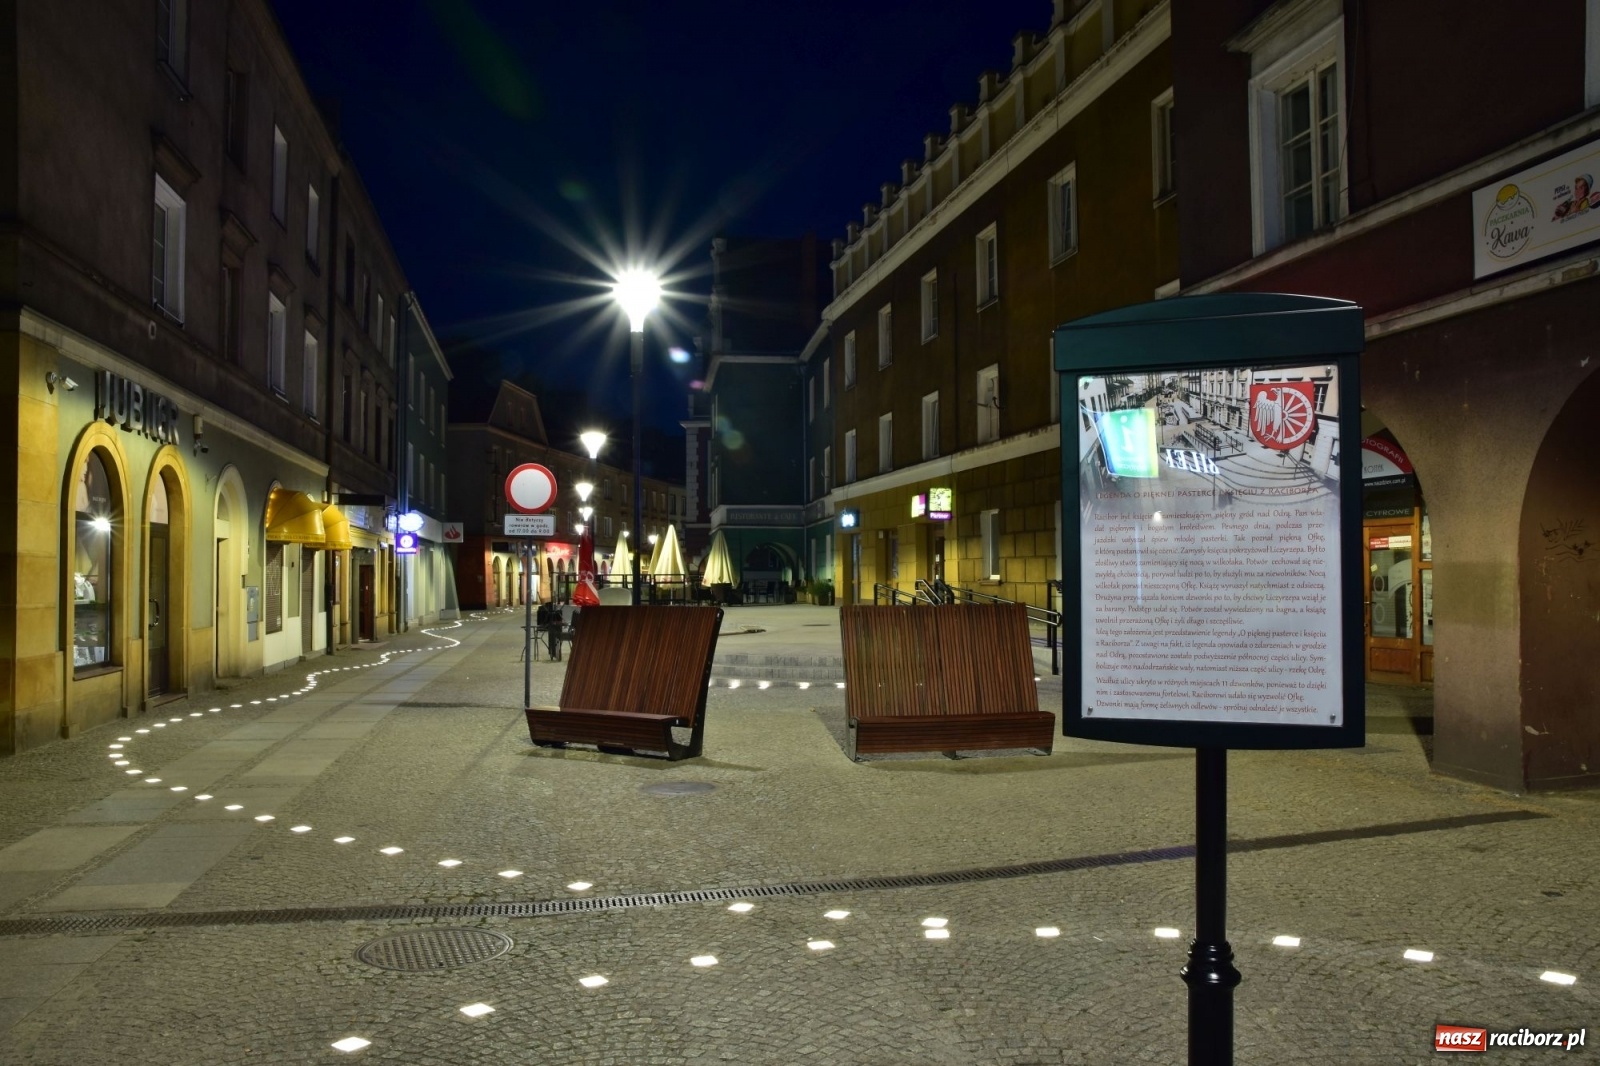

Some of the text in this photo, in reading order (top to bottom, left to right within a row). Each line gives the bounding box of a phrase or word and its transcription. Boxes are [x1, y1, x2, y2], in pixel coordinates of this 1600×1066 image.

[1490, 206, 1530, 227] PĄCZKARNIA
[1491, 225, 1530, 250] Kawa
[1366, 508, 1410, 516] CYFROWE
